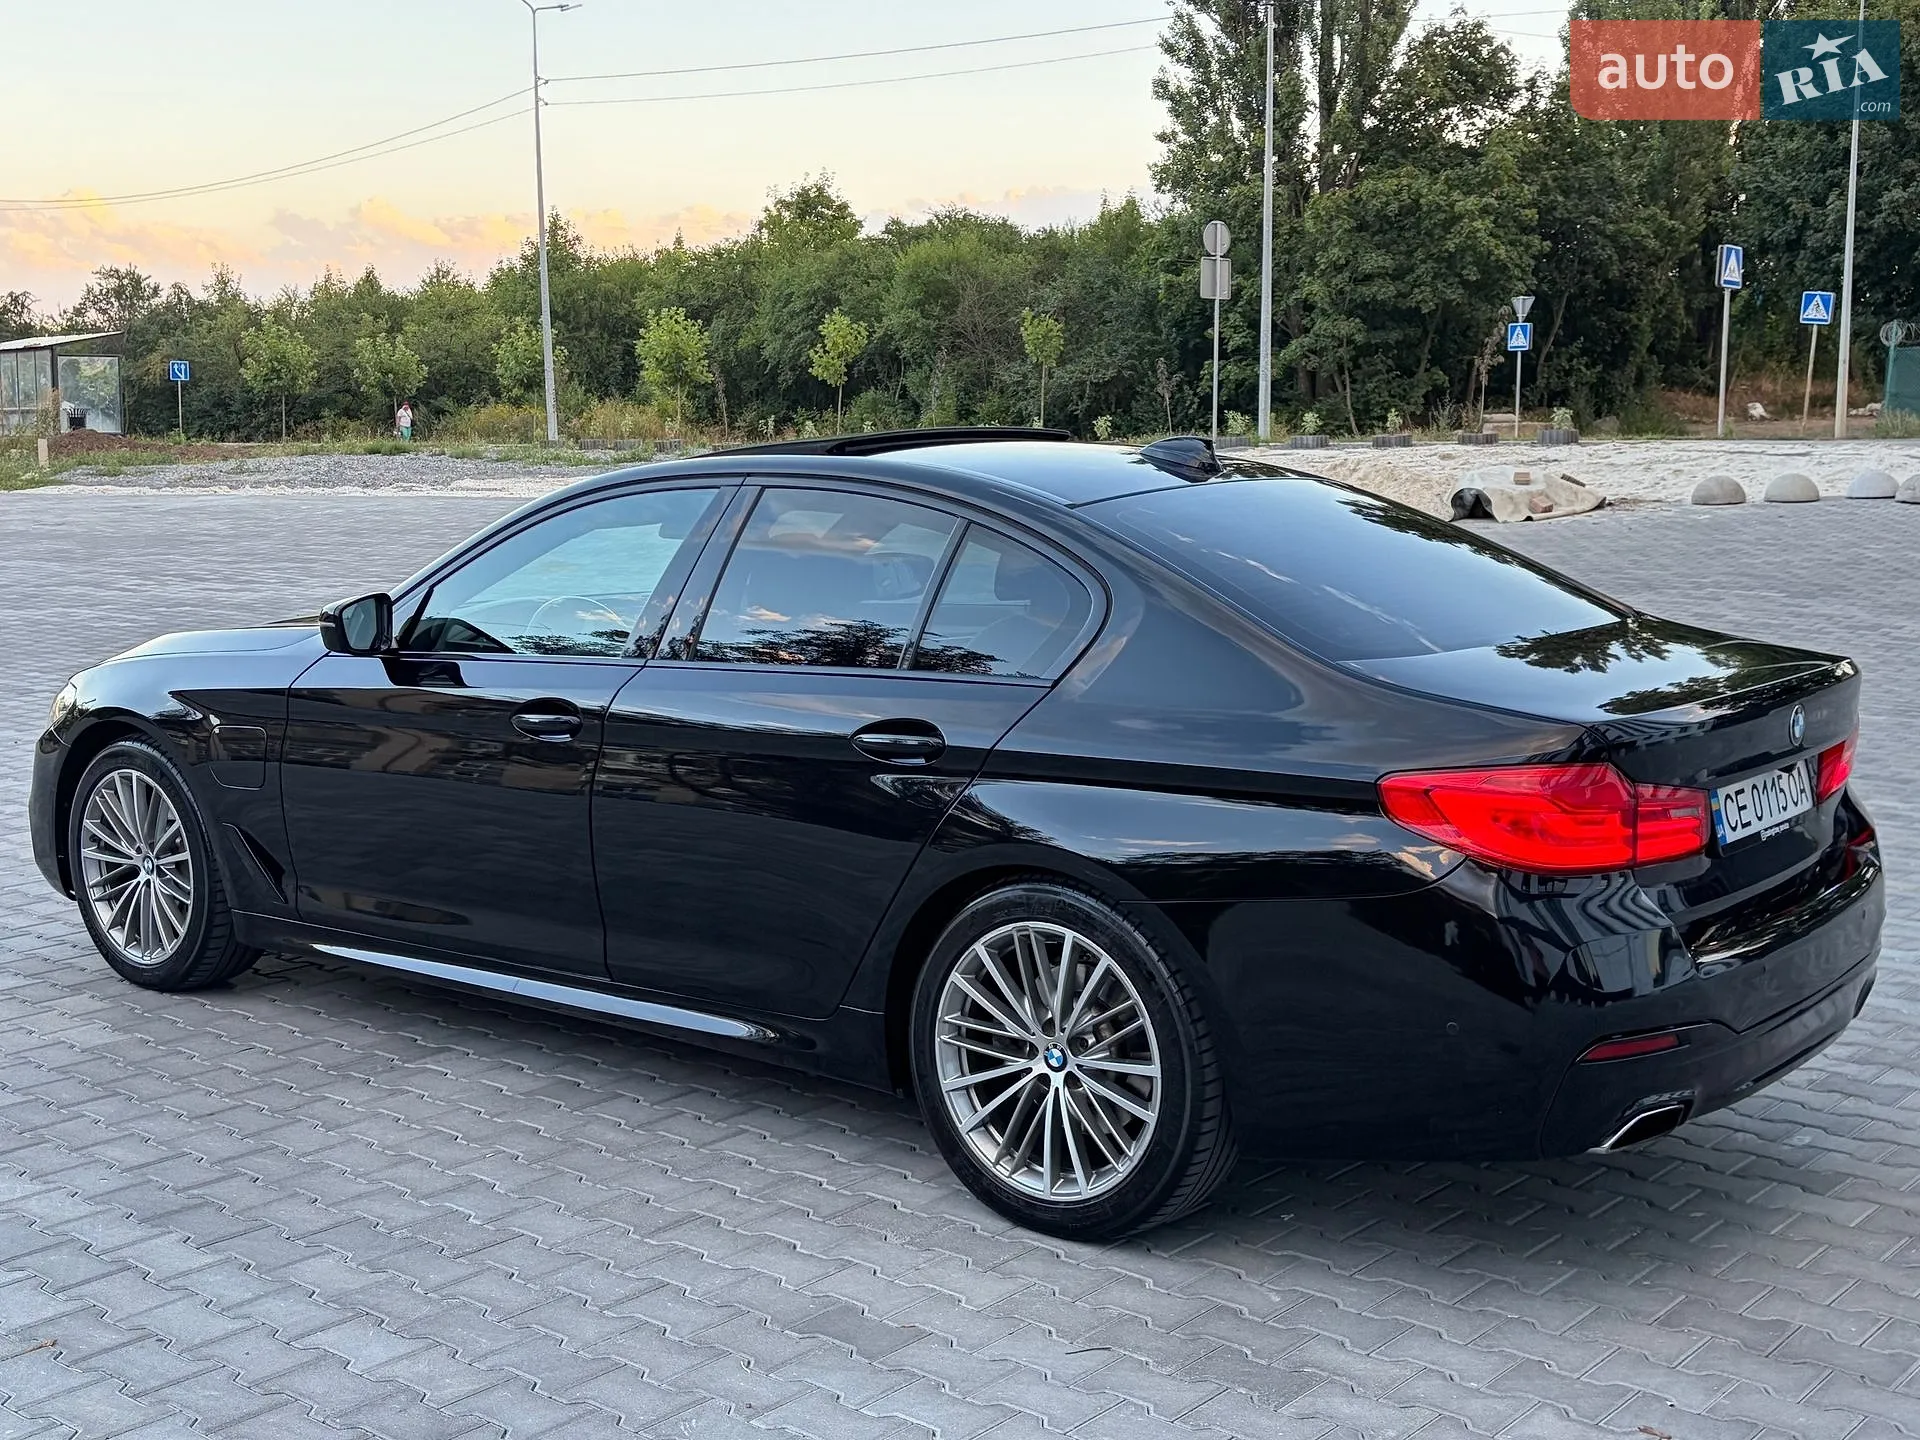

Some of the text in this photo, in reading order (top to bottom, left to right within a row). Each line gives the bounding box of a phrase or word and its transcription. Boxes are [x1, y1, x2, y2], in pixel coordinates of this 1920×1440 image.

[1724, 788, 1752, 832] CE
[1752, 774, 1788, 821] 0115
[1788, 766, 1809, 807] OA
